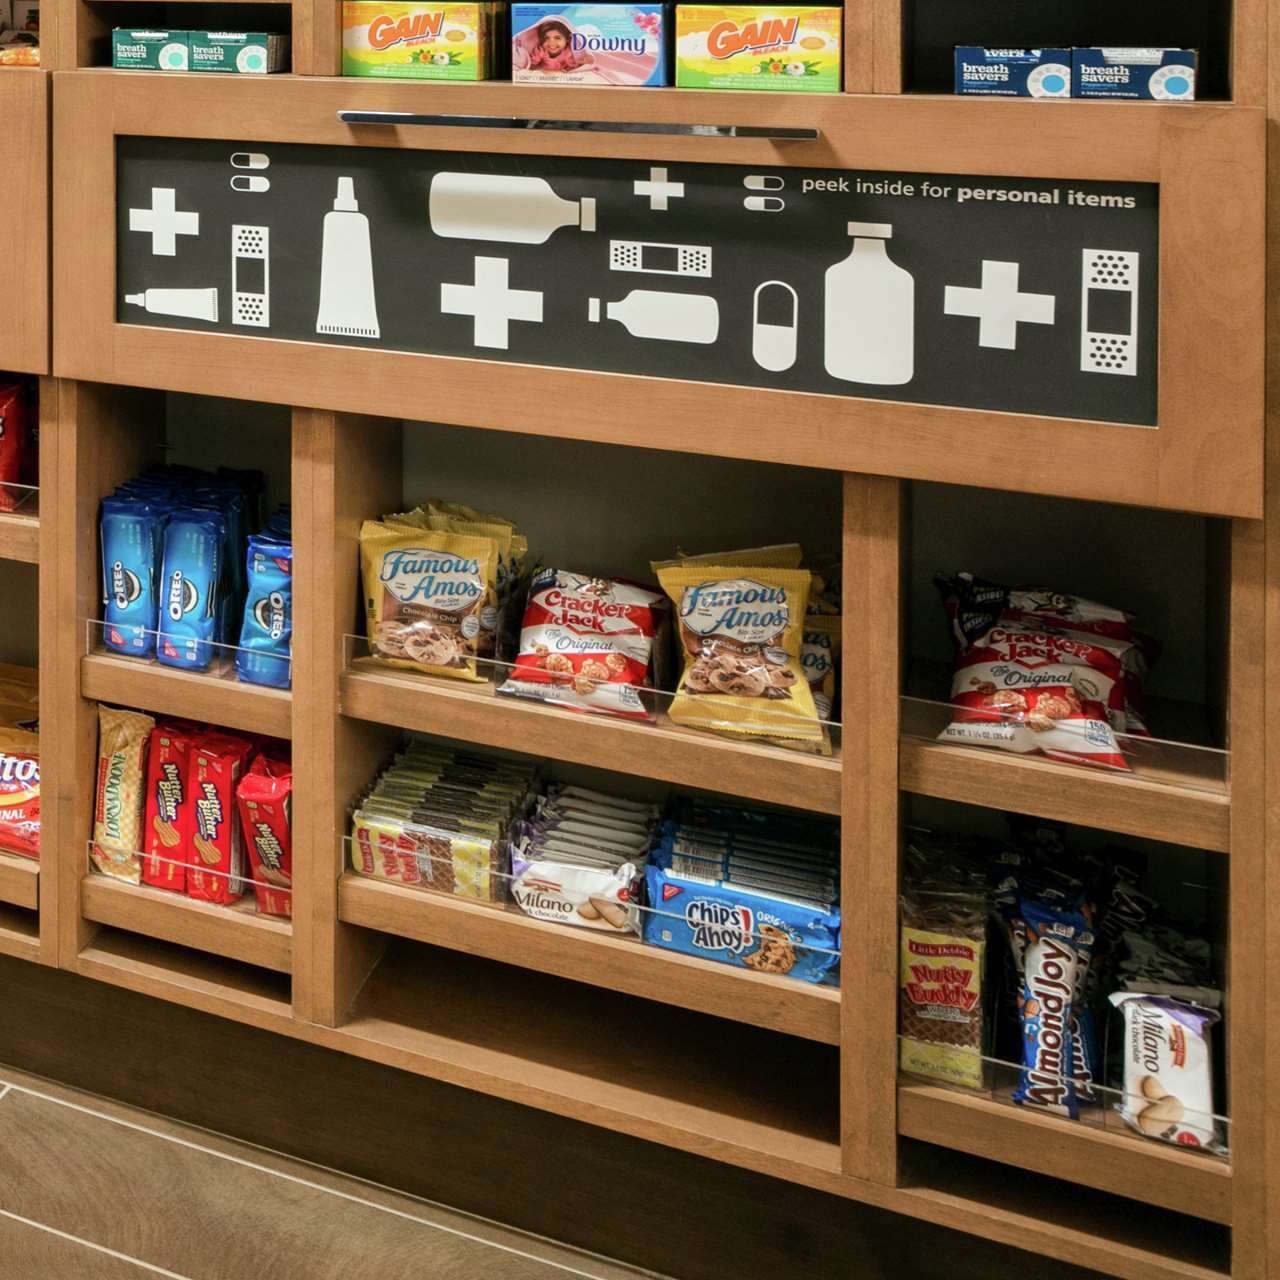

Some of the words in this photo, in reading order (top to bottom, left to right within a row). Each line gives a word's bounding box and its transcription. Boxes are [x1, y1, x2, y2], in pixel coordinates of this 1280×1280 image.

[367, 11, 445, 50] GAIN
[571, 32, 645, 55] Downy
[706, 16, 799, 59] GAIN
[117, 43, 146, 52] breath
[117, 51, 146, 59] savers
[192, 45, 224, 54] breath
[192, 53, 224, 61] savers
[963, 63, 1009, 74] breath
[963, 73, 1009, 82] savers
[1080, 64, 1130, 75] breath
[1080, 73, 1130, 84] savers
[802, 177, 850, 193] peek
[856, 178, 915, 196] inside
[920, 182, 953, 198] for
[957, 186, 1060, 205] personal
[1067, 190, 1136, 208] items
[379, 550, 481, 582] Famous
[112, 560, 129, 610] OREO
[168, 570, 184, 621] OREO
[411, 574, 483, 603] Amos
[544, 590, 632, 619] Cracker
[680, 584, 788, 617] Famous
[552, 611, 607, 632] Jack
[715, 607, 790, 631] Amos
[554, 634, 615, 653] Original
[989, 628, 1093, 660] Cracker
[999, 642, 1062, 663] Jack
[1004, 671, 1074, 688] Original
[162, 764, 183, 804] Nutter
[158, 781, 176, 822] Butter
[202, 783, 223, 824] Nutter
[197, 799, 217, 840] Butter
[685, 901, 741, 930] Chips
[1042, 937, 1072, 996] Joy
[1025, 995, 1071, 1107] Almond
[1138, 1004, 1168, 1074] Milano
